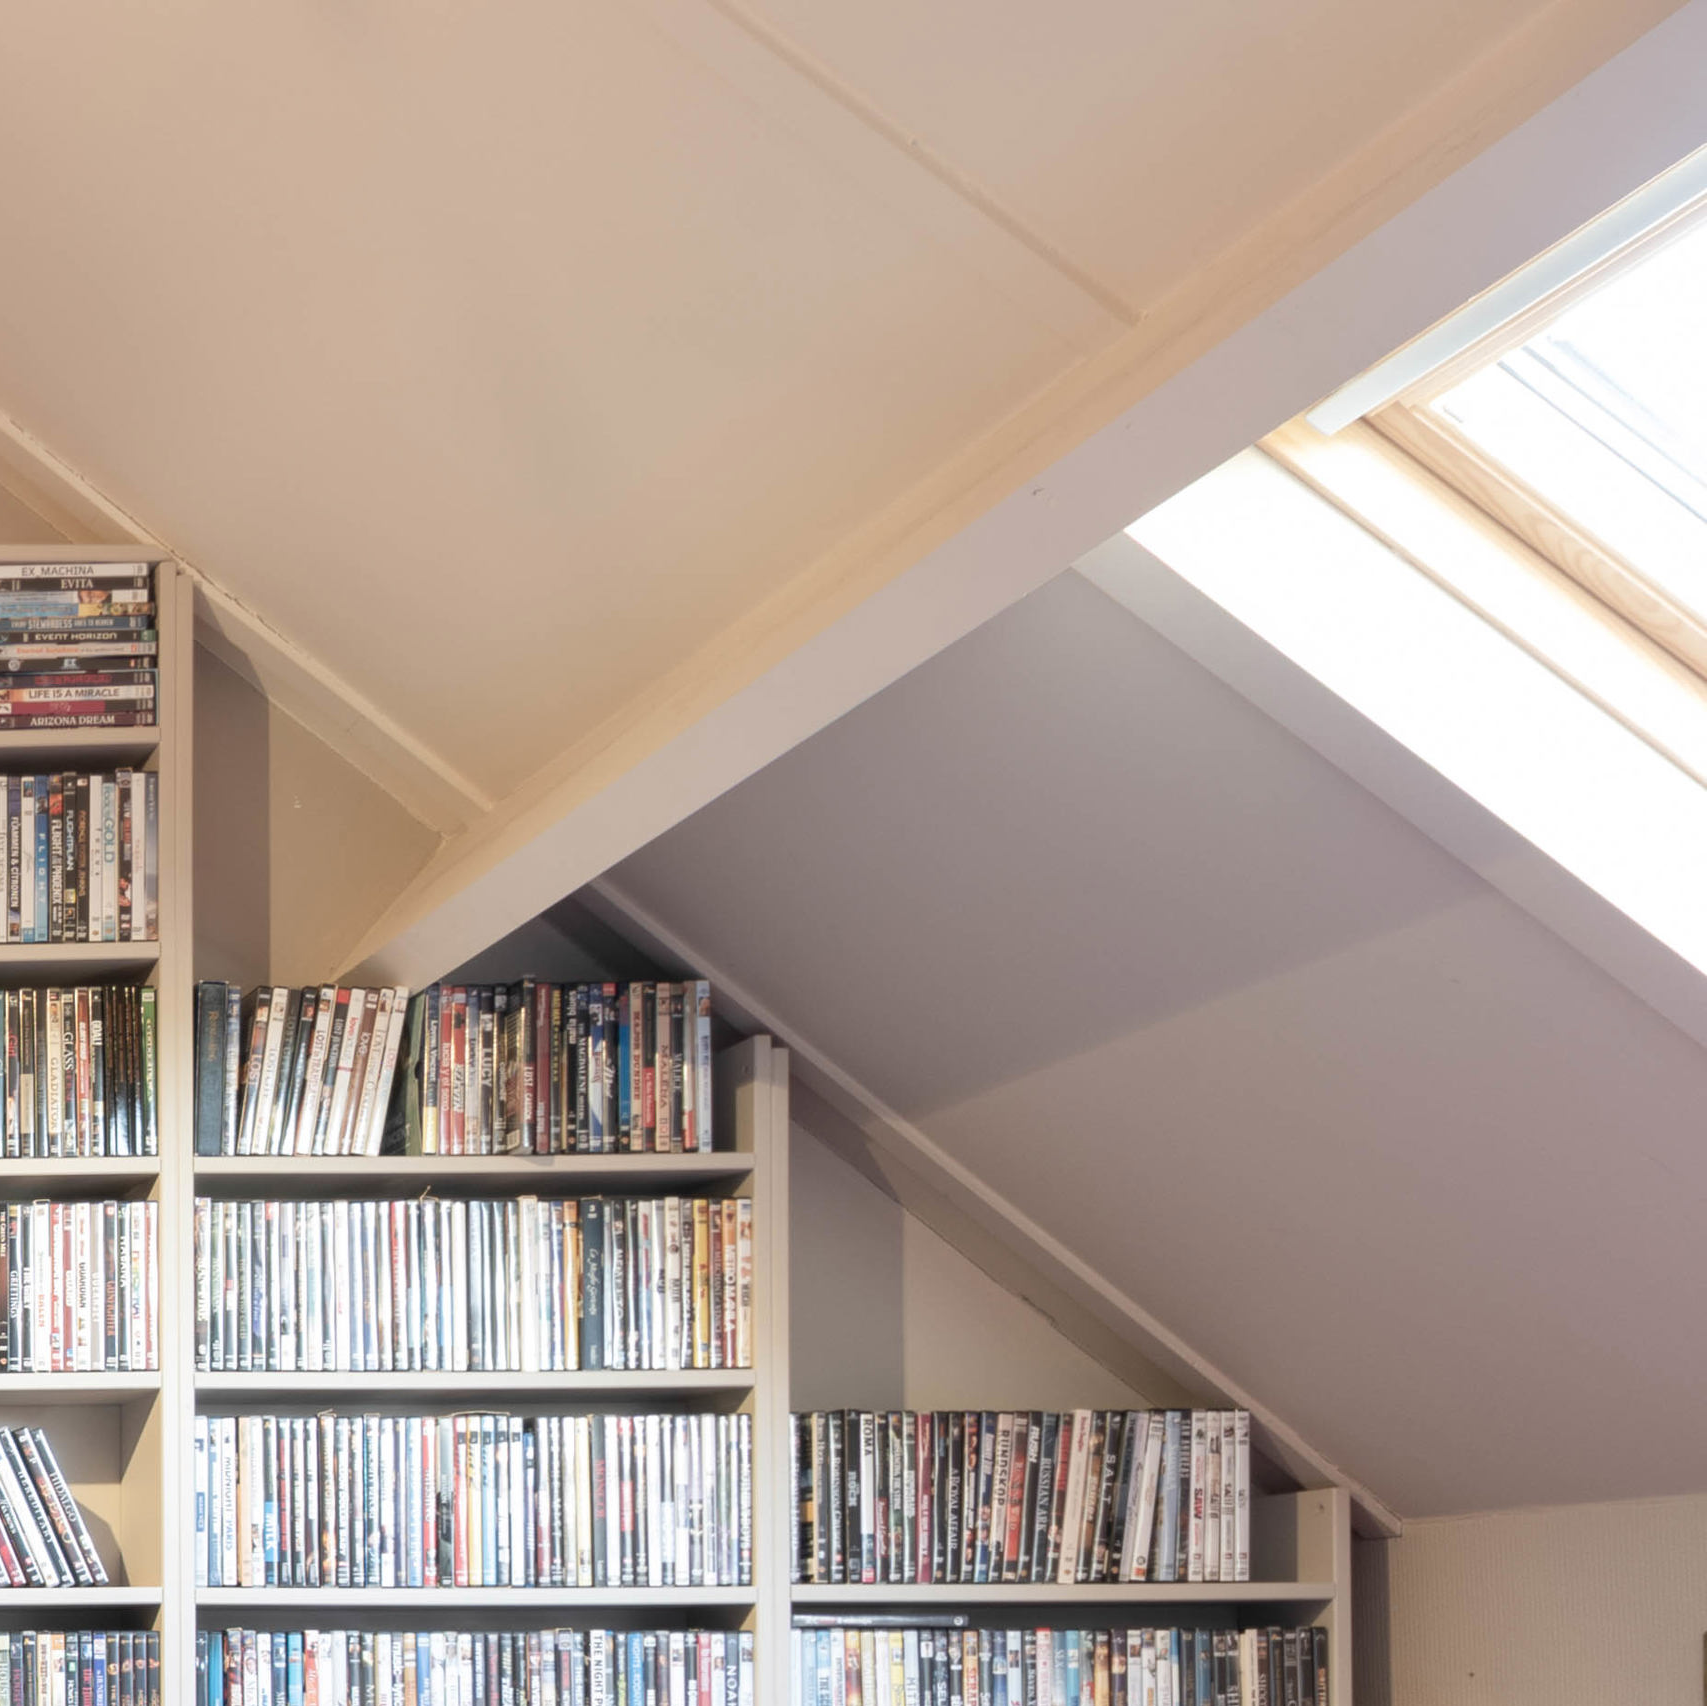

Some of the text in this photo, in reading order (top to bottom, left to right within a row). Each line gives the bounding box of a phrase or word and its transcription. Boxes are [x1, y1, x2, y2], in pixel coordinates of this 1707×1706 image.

[60, 579, 93, 588] EVITA
[79, 715, 115, 725] DREAM
[51, 819, 63, 904] FLIGHT PHOENIX
[481, 1048, 493, 1087] LUCY
[863, 1418, 873, 1456] ROMA
[995, 1430, 1009, 1506] RUNDSKOP
[594, 1635, 604, 1657] THE
[594, 1659, 604, 1692] NIGHT
